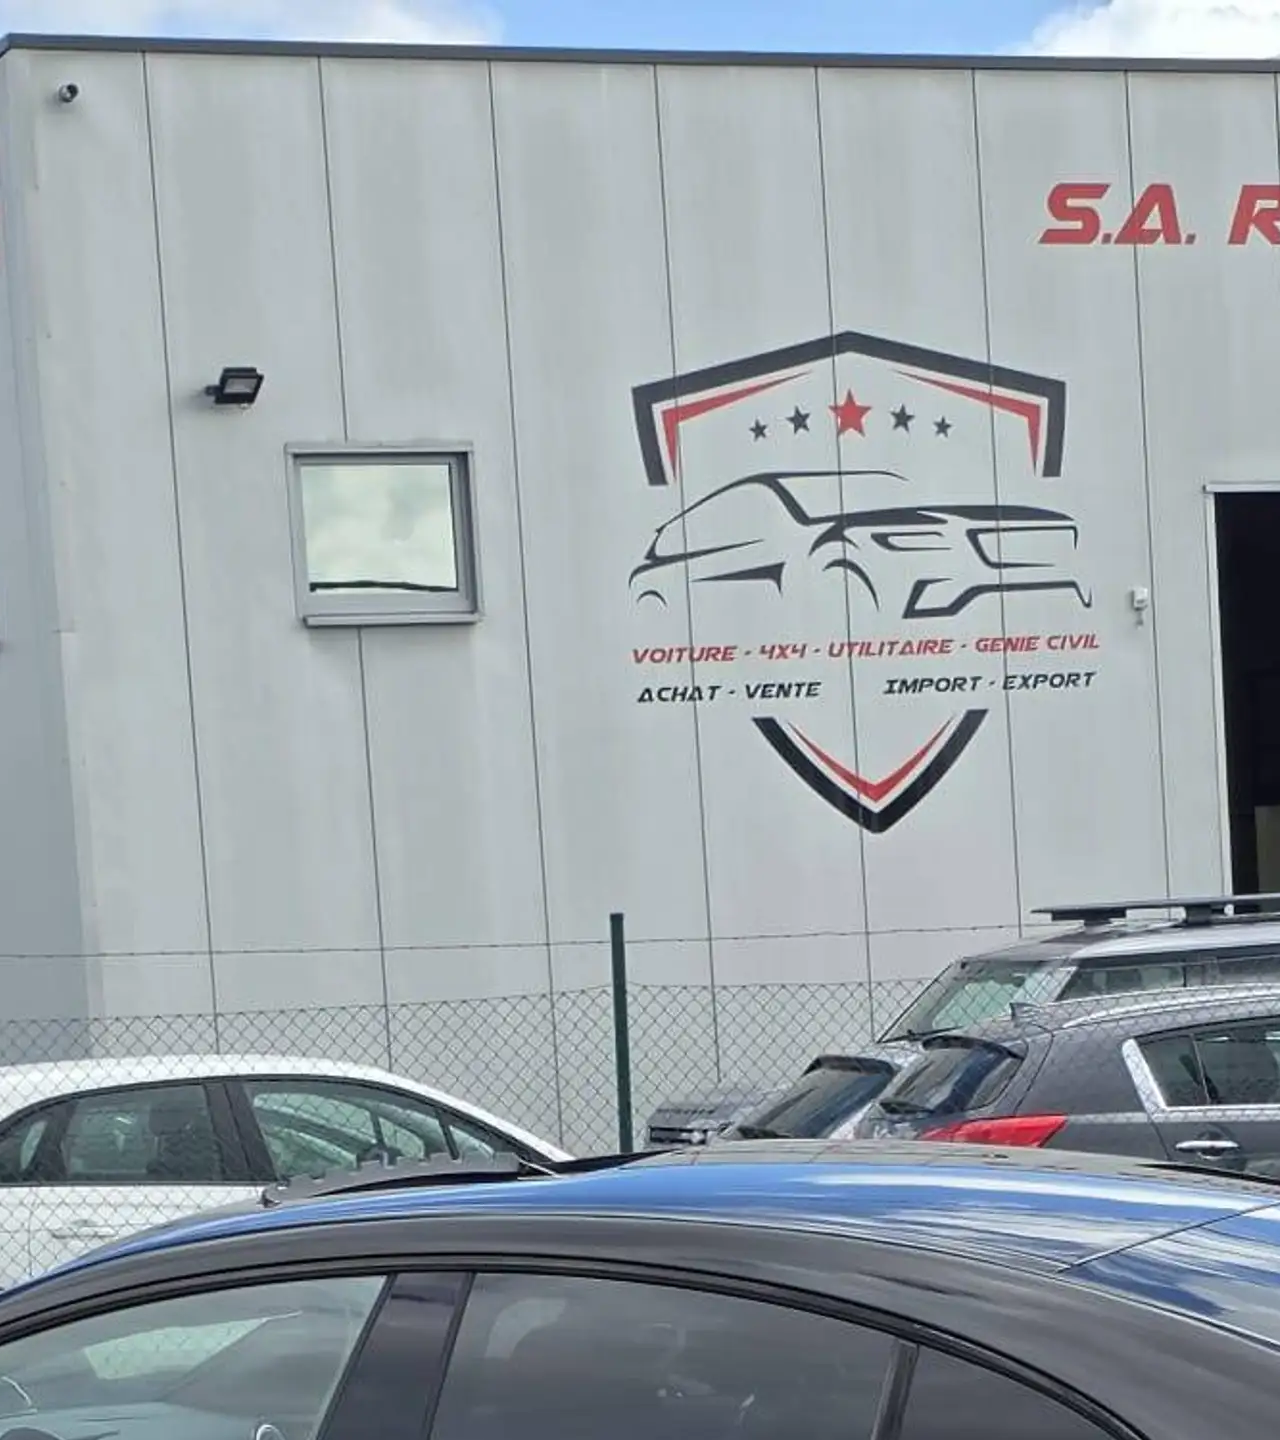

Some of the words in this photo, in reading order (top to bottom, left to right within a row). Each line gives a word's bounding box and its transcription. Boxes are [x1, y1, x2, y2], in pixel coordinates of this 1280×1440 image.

[1039, 182, 1195, 247] S.A.
[632, 645, 738, 664] VOITURE
[759, 643, 808, 660] 4X4
[827, 638, 954, 659] UTILITAIRE
[974, 635, 1041, 654] GENIE
[1046, 634, 1100, 651] CIVIL
[636, 685, 722, 703] ACHAT
[744, 681, 822, 700] VENTE
[882, 675, 983, 695] IMPORT
[1002, 671, 1098, 691] EXPORT
